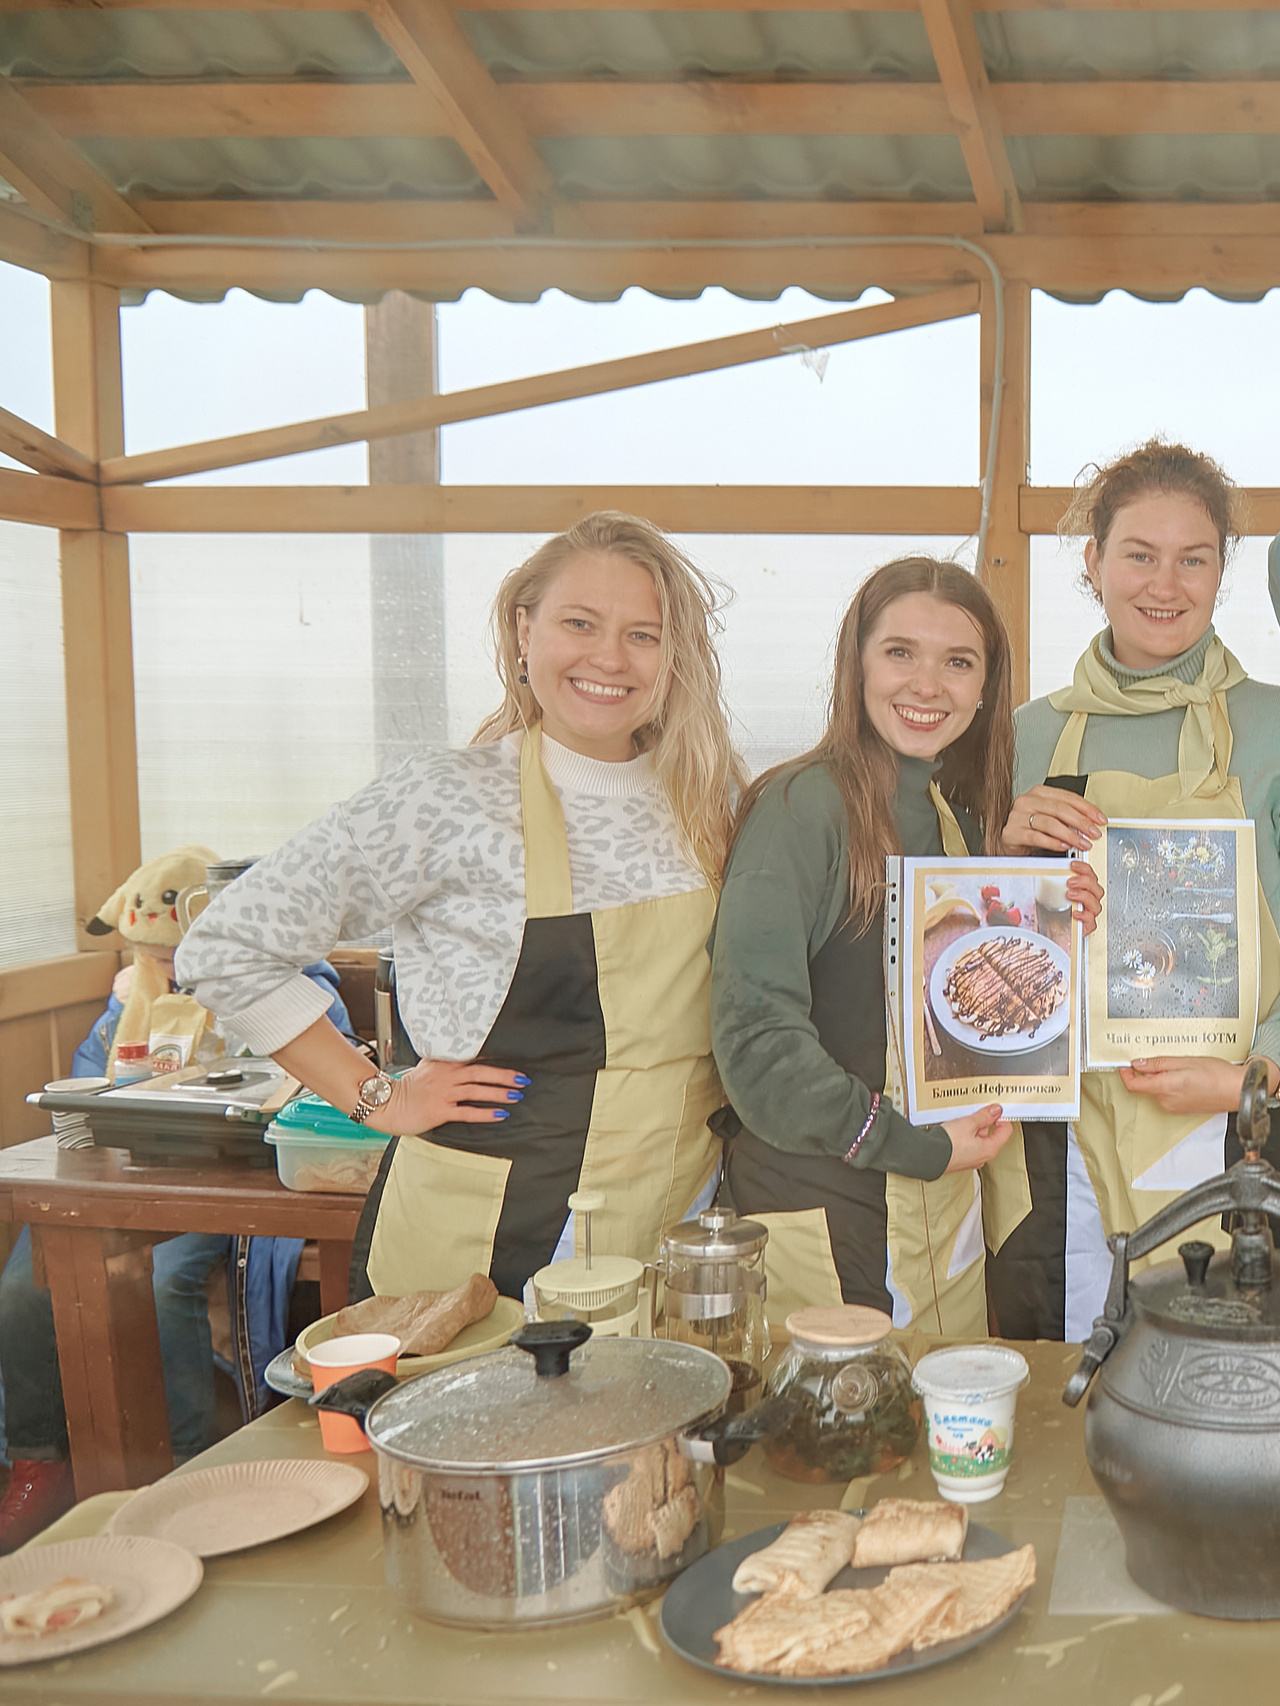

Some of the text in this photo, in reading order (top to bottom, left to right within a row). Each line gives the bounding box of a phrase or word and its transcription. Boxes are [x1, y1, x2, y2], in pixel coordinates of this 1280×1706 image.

[1106, 1032, 1237, 1046] Чай с травами ЮТМ
[932, 1082, 1061, 1099] Блины «Нефтяночка»
